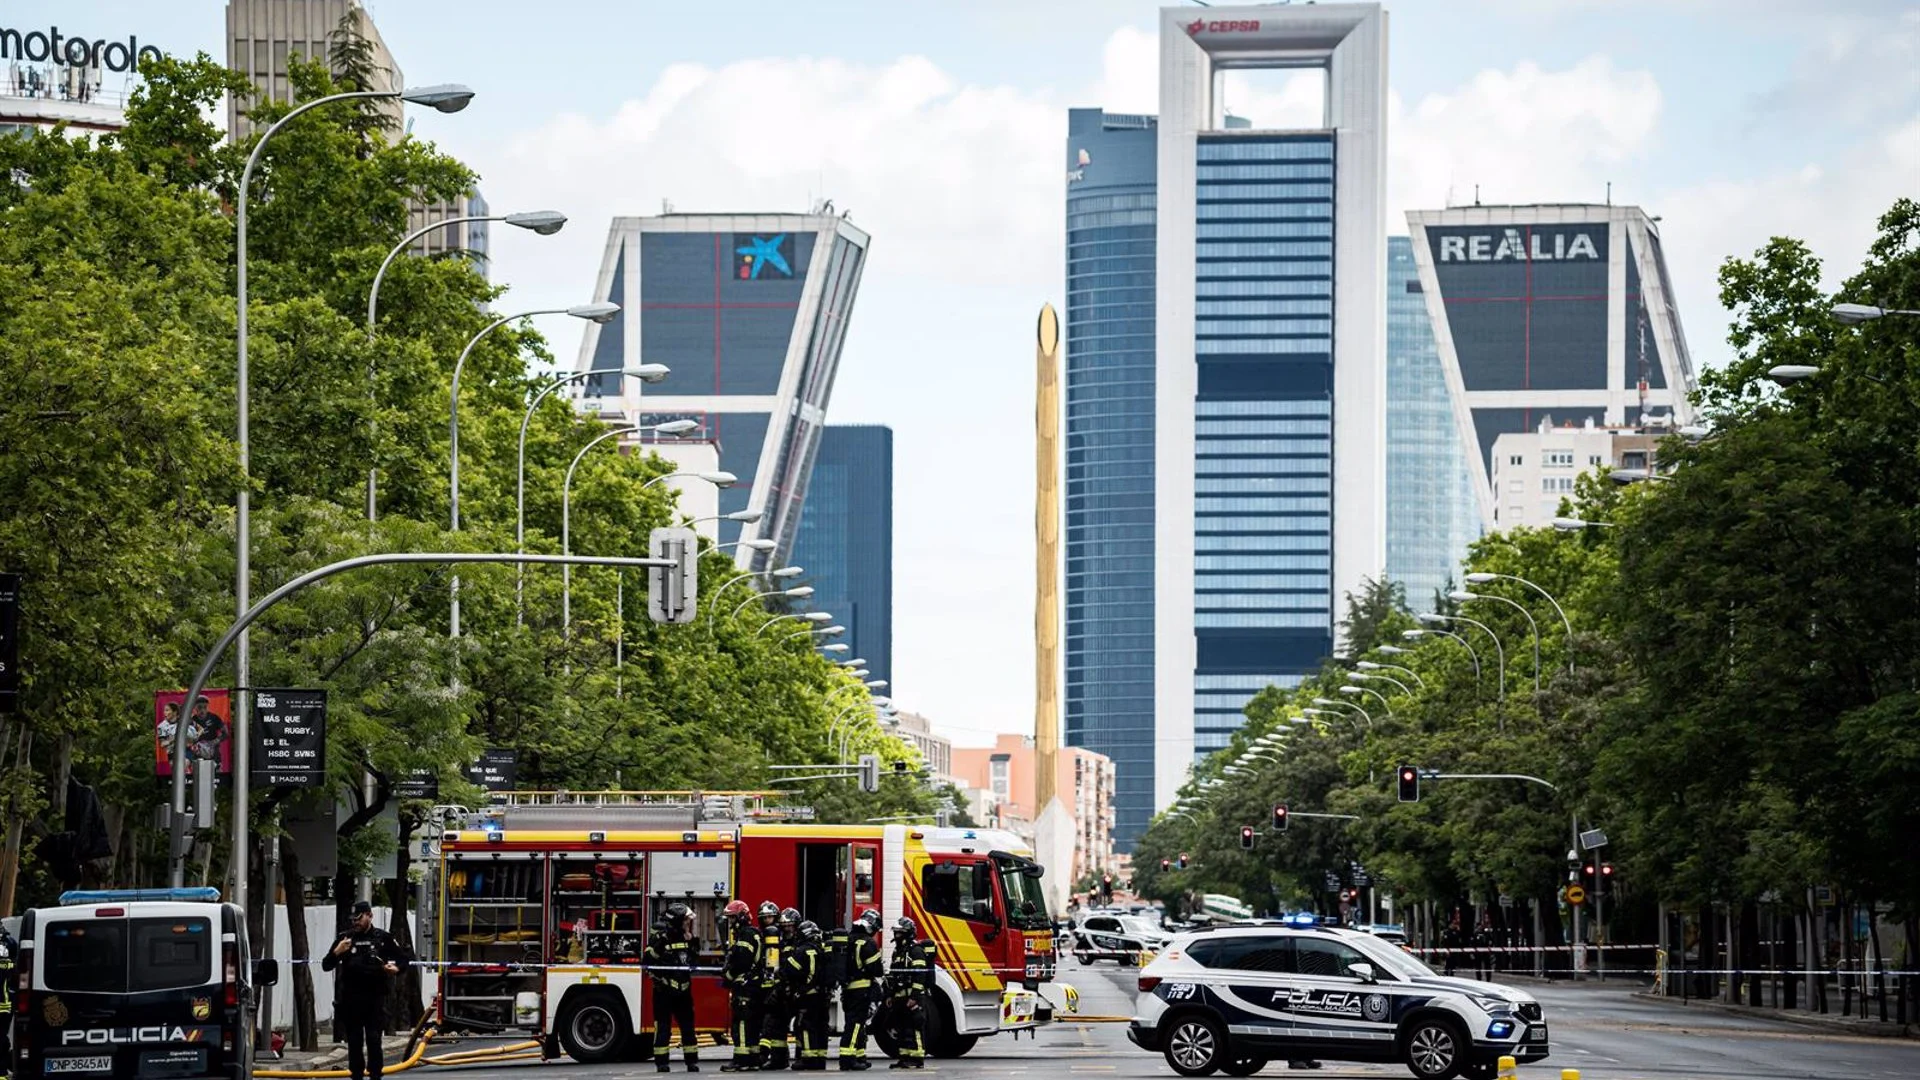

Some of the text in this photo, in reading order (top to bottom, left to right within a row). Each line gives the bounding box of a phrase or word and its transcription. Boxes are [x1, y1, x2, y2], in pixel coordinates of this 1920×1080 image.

[1208, 21, 1260, 32] CEPSA
[1440, 228, 1599, 262] REALIA
[263, 714, 301, 723] MÁS QUE
[284, 727, 314, 735] RUGBY,
[263, 738, 290, 746] ES EL
[713, 881, 725, 891] A2
[1170, 983, 1191, 991] 092
[1167, 991, 1184, 999] 112
[1271, 990, 1362, 1007] POLICÍA
[1324, 1005, 1362, 1013] MADRID
[62, 1023, 188, 1045] POLICÍA
